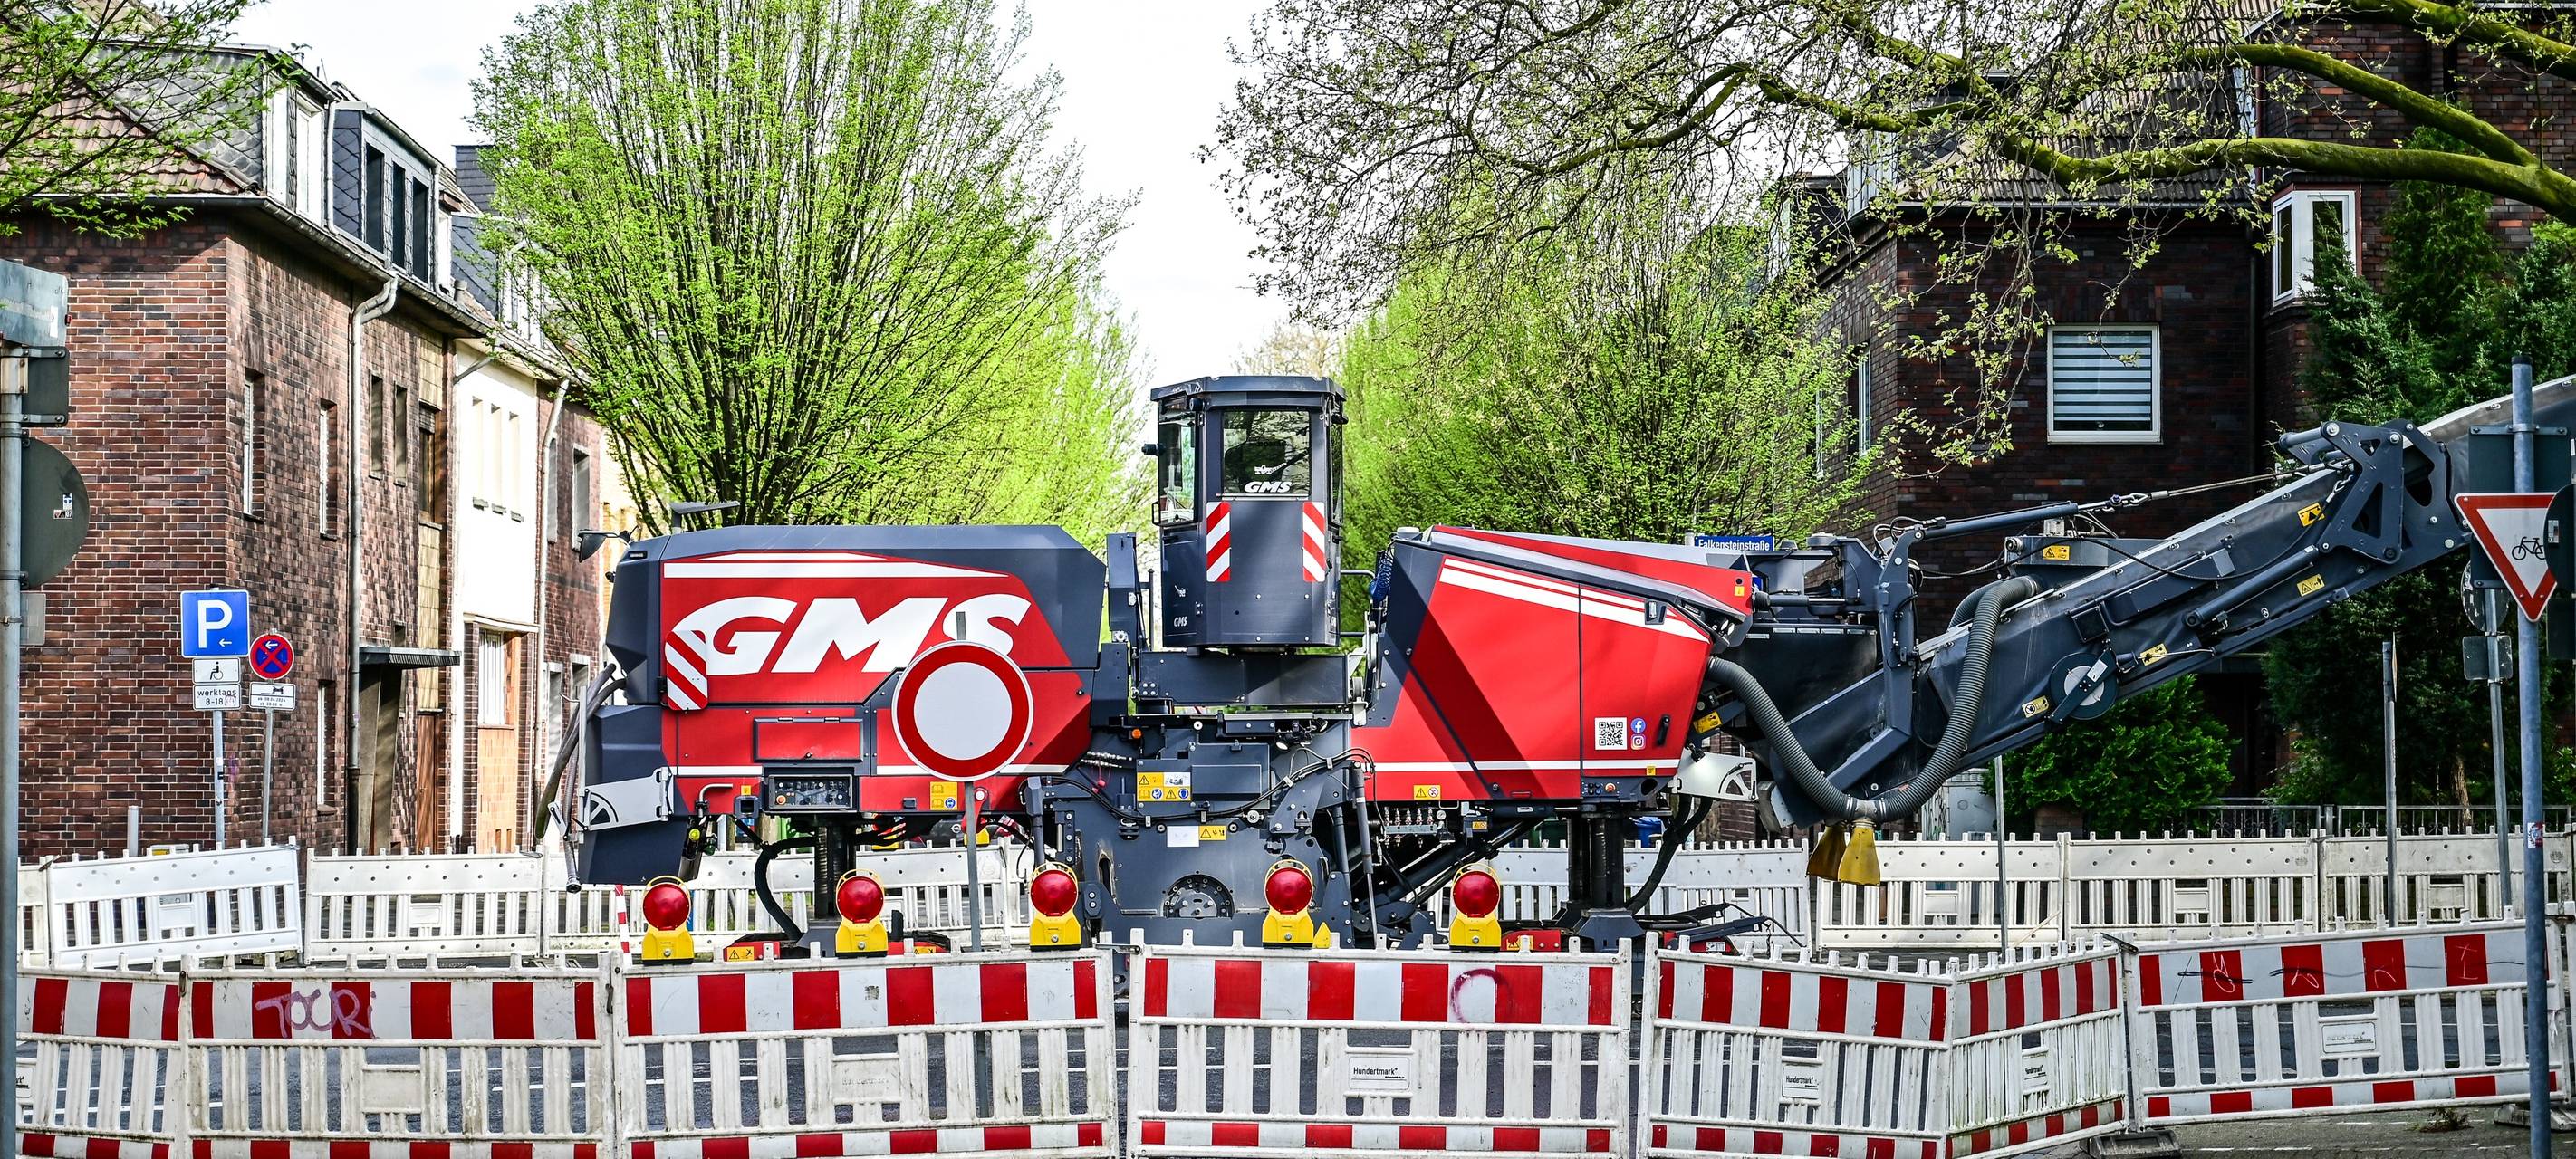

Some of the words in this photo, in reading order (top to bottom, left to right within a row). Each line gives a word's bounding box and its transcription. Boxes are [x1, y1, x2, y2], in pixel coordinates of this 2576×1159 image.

[1244, 481, 1293, 493] GMS
[1698, 539, 1770, 551] Falkensteinstraße
[197, 599, 233, 648] P
[1173, 616, 1188, 627] GMS
[672, 594, 1031, 675] GMS
[197, 689, 237, 697] werktags
[206, 697, 224, 705] 8-18
